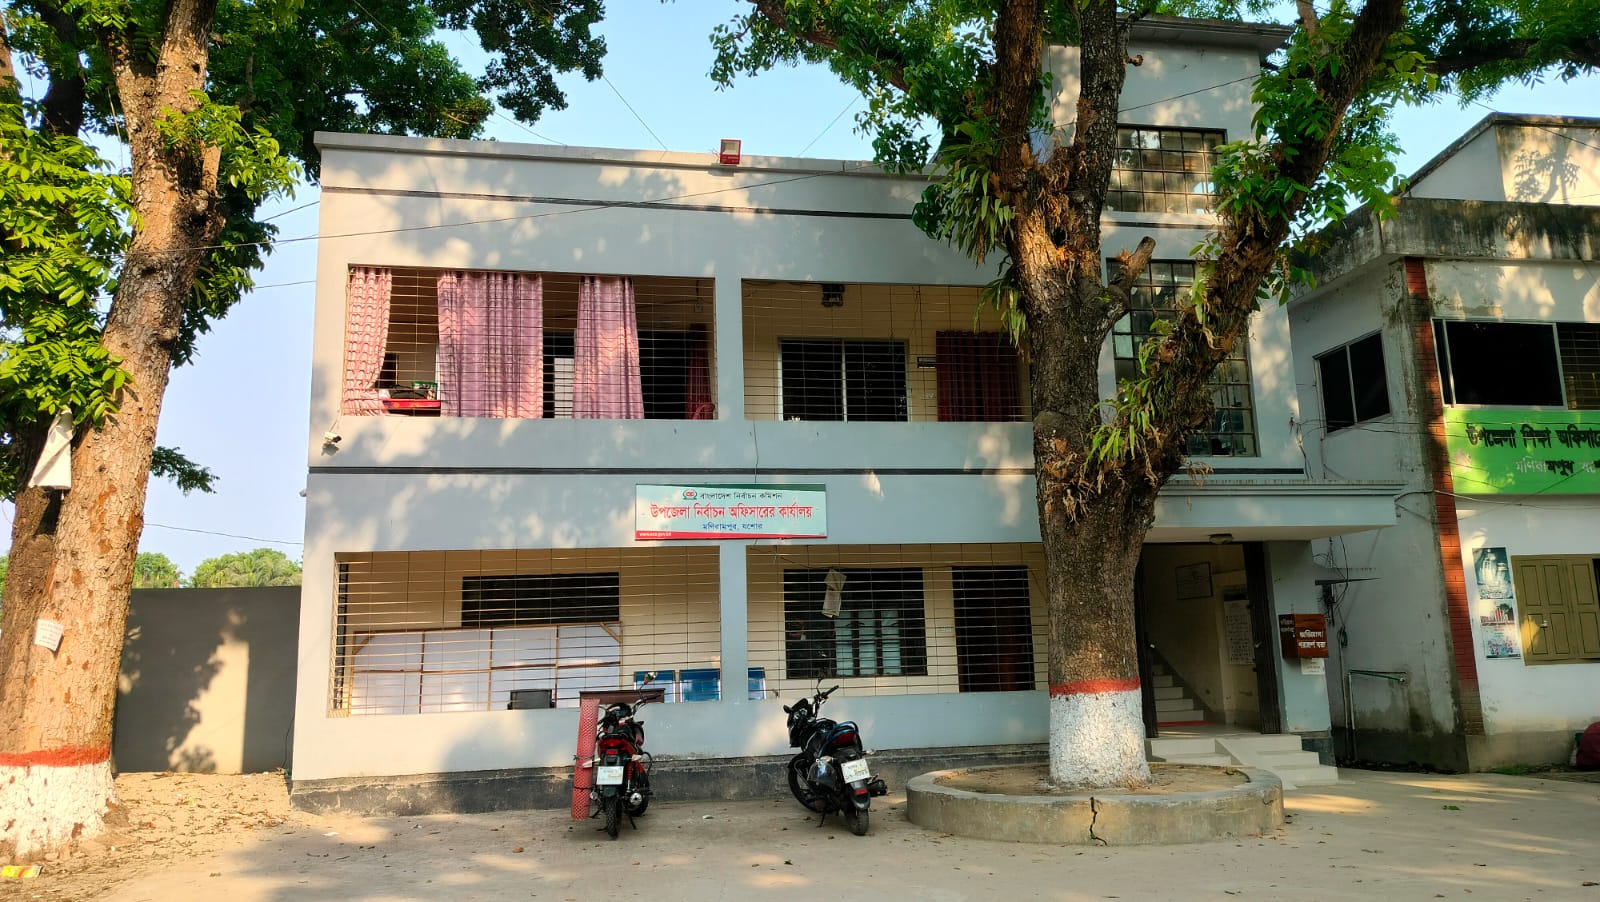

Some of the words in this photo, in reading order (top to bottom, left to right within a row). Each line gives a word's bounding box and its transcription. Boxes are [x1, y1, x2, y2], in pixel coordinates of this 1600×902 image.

[700, 492, 731, 500] বাংলাদেশ
[733, 491, 757, 500] নির্বাচন
[759, 491, 782, 500] কমিশন
[649, 503, 690, 519] উপজেলা
[693, 502, 725, 519] নির্বাচন
[728, 502, 775, 518] অফিসারের
[778, 502, 813, 518] কার্যালয়
[742, 522, 763, 530] যশোর
